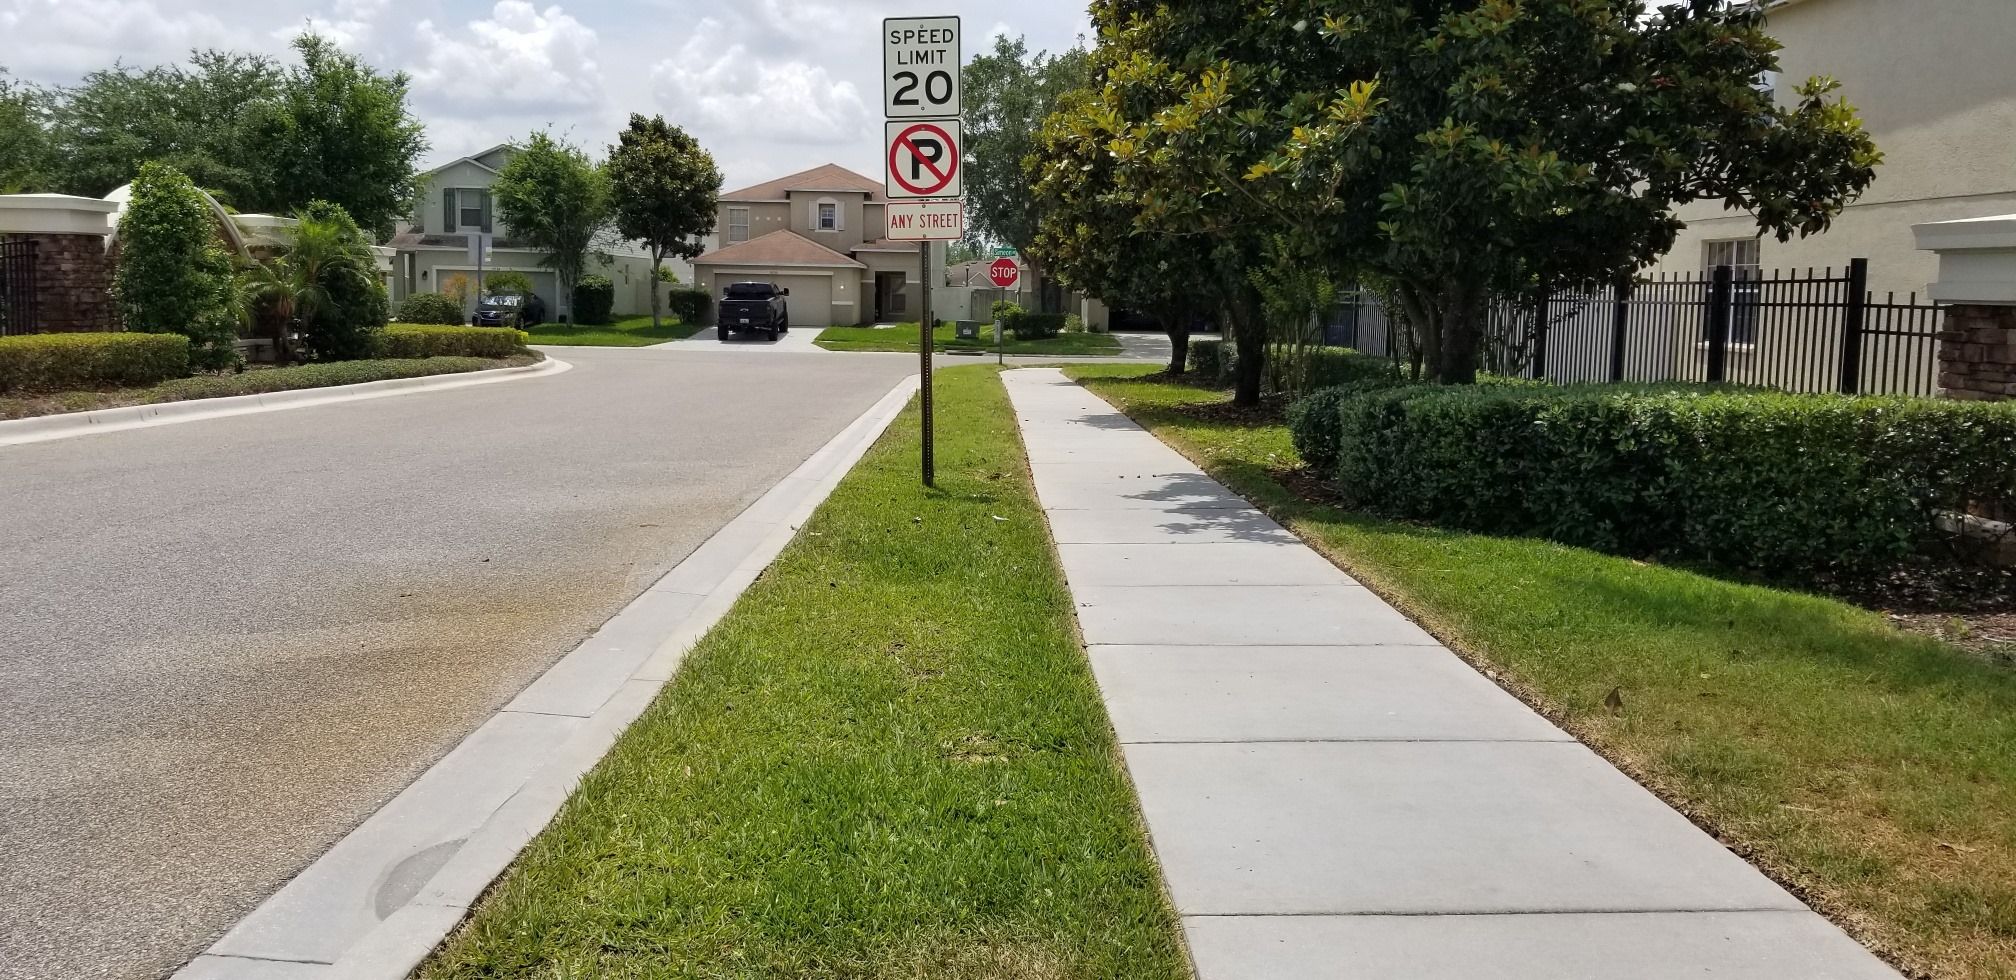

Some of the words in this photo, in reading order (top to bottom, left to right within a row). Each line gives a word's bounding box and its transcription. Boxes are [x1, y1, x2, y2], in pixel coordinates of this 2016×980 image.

[890, 29, 954, 45] SPEED
[897, 49, 947, 65] LIMIT
[892, 70, 953, 106] 20
[911, 138, 943, 180] P
[890, 214, 913, 229] ANY
[919, 213, 958, 229] STREET
[991, 267, 1017, 278] STOP
